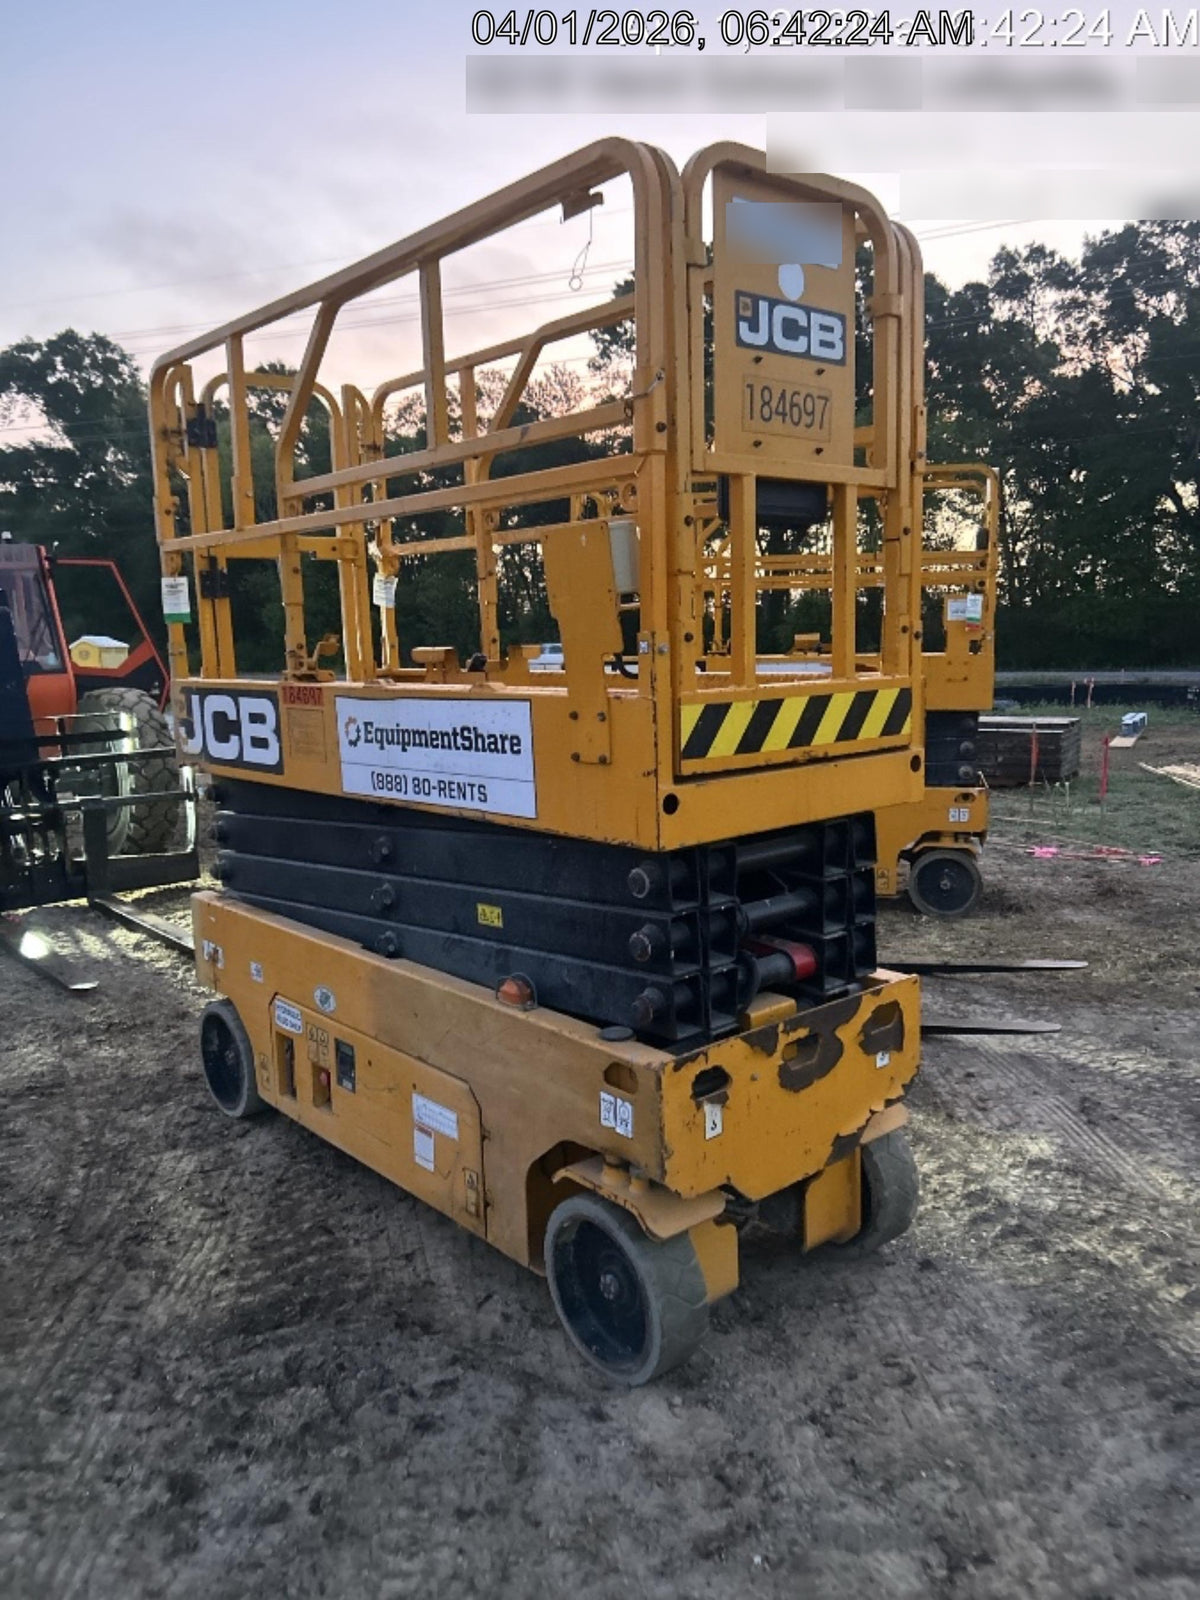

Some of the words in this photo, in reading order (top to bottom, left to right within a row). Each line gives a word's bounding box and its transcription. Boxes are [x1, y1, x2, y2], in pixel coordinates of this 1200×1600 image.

[738, 299, 844, 361] JCB
[746, 382, 830, 431] 184697
[178, 693, 281, 766] JCB
[363, 720, 522, 756] EquipmentShare
[370, 770, 408, 796] (888)
[411, 776, 488, 804] 80-RENTS
